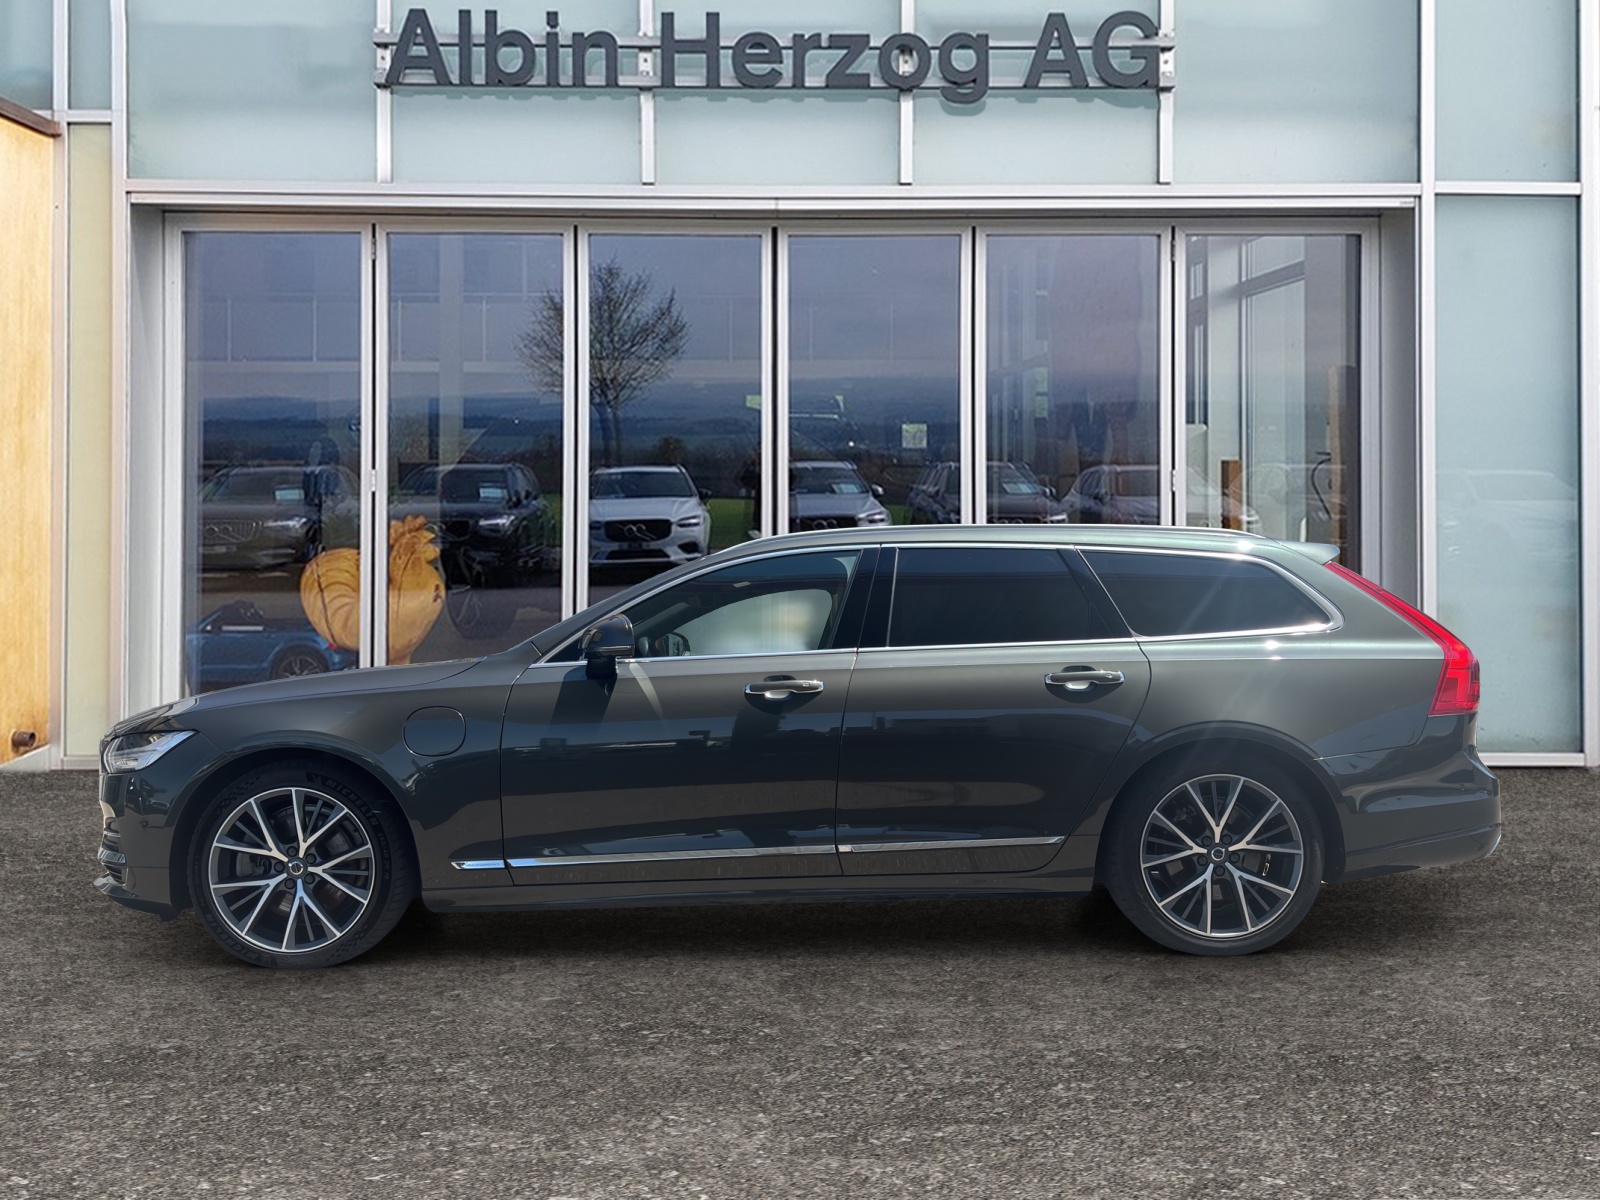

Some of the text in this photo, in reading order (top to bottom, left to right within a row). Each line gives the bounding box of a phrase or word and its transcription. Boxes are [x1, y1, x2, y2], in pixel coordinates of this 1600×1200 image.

[384, 8, 1161, 105] Albin Herzog AG
[324, 779, 379, 826] MICHELIN
